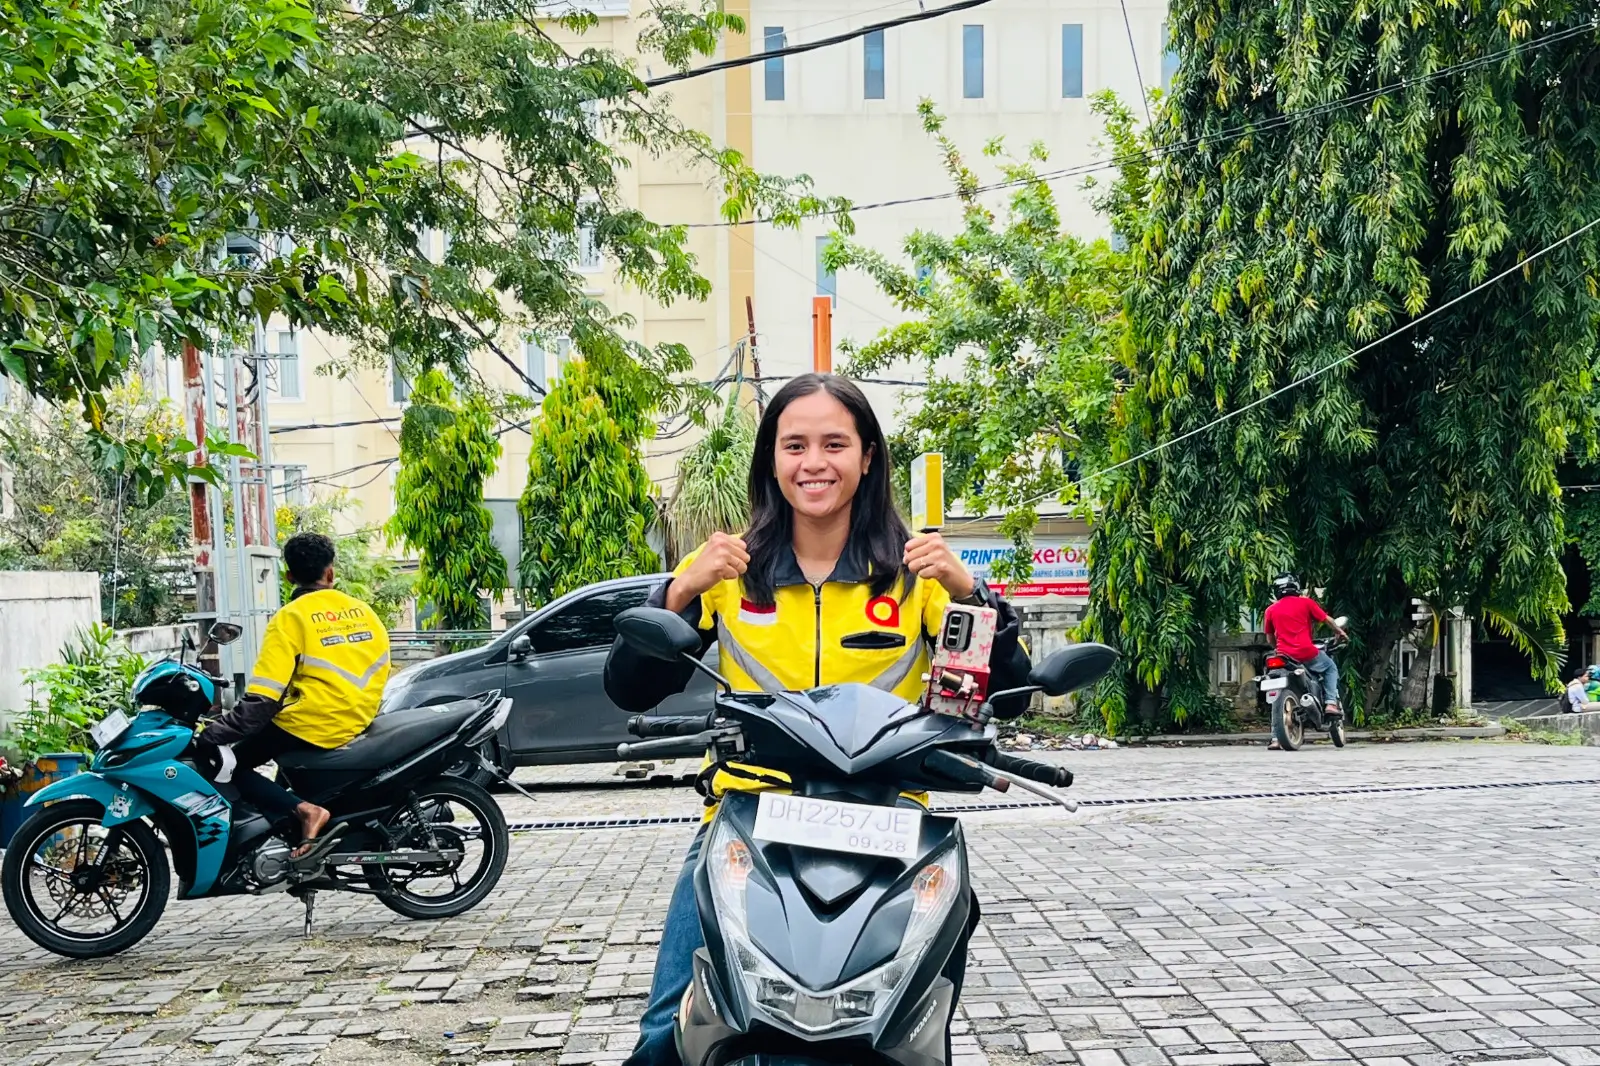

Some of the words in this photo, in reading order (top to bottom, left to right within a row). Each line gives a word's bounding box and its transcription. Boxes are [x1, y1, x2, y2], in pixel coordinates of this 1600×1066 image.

[1055, 569, 1074, 577] DESIGN
[311, 607, 364, 624] maxim
[849, 835, 906, 853] 09.28
[909, 999, 938, 1042] HONDA
